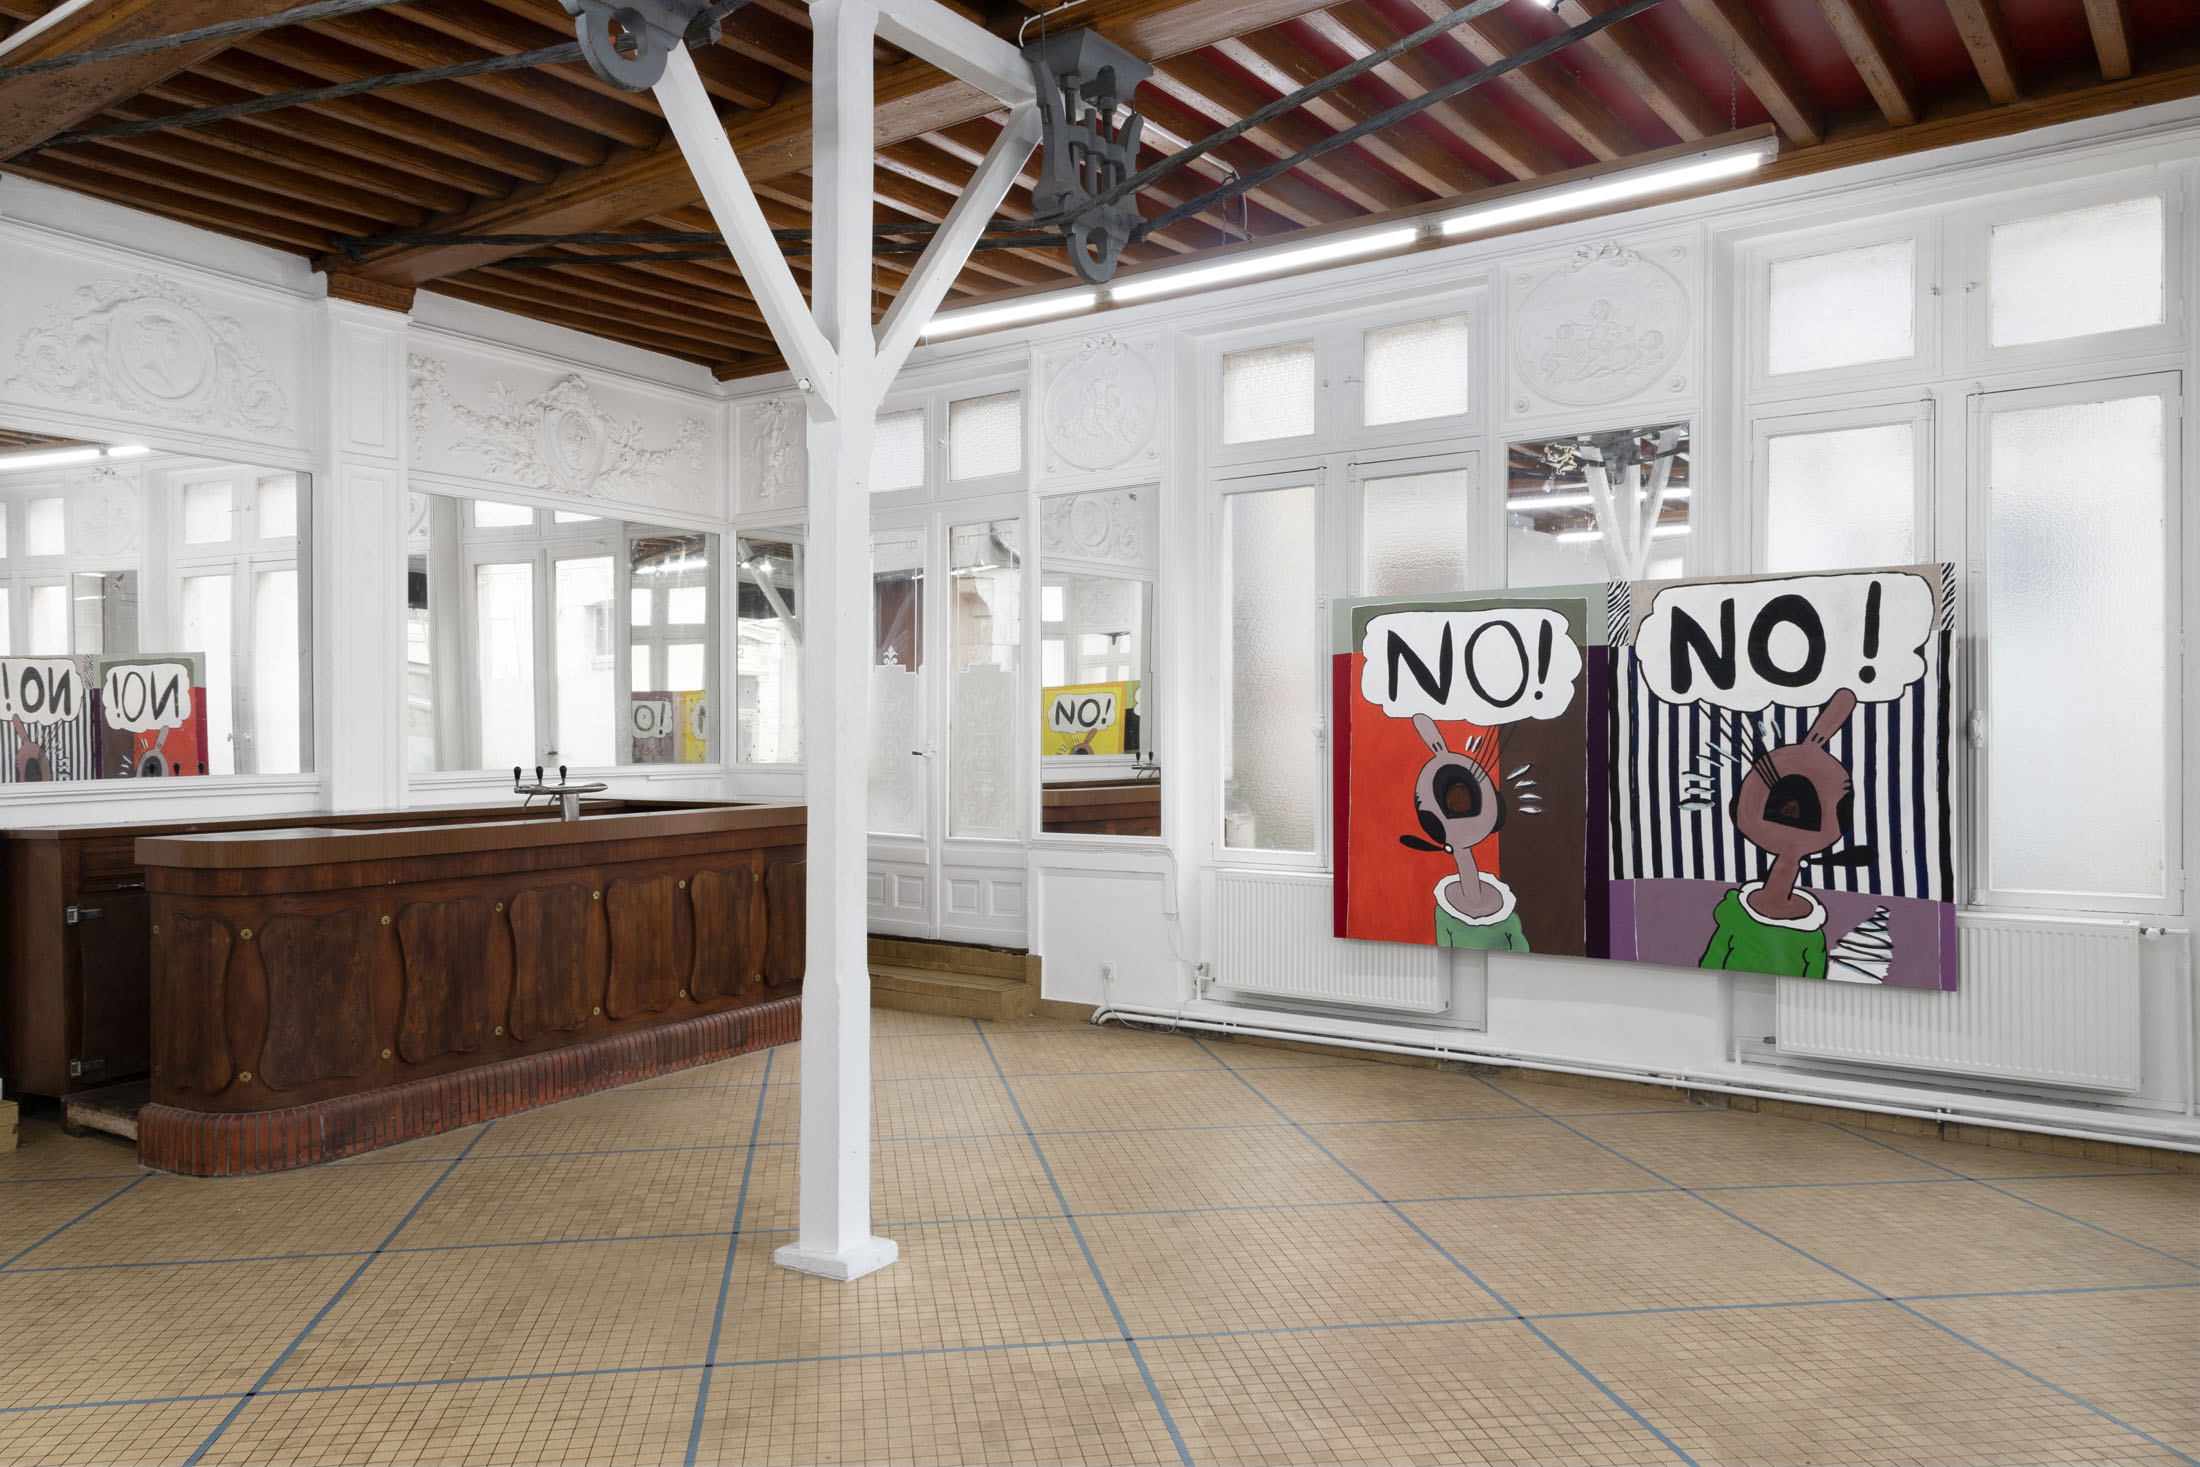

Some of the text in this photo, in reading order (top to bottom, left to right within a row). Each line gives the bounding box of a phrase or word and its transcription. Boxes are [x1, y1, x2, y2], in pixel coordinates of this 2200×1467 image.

[1388, 619, 1553, 708] NO!
[1670, 581, 1882, 695] NO!
[1055, 698, 1112, 727] NO!
